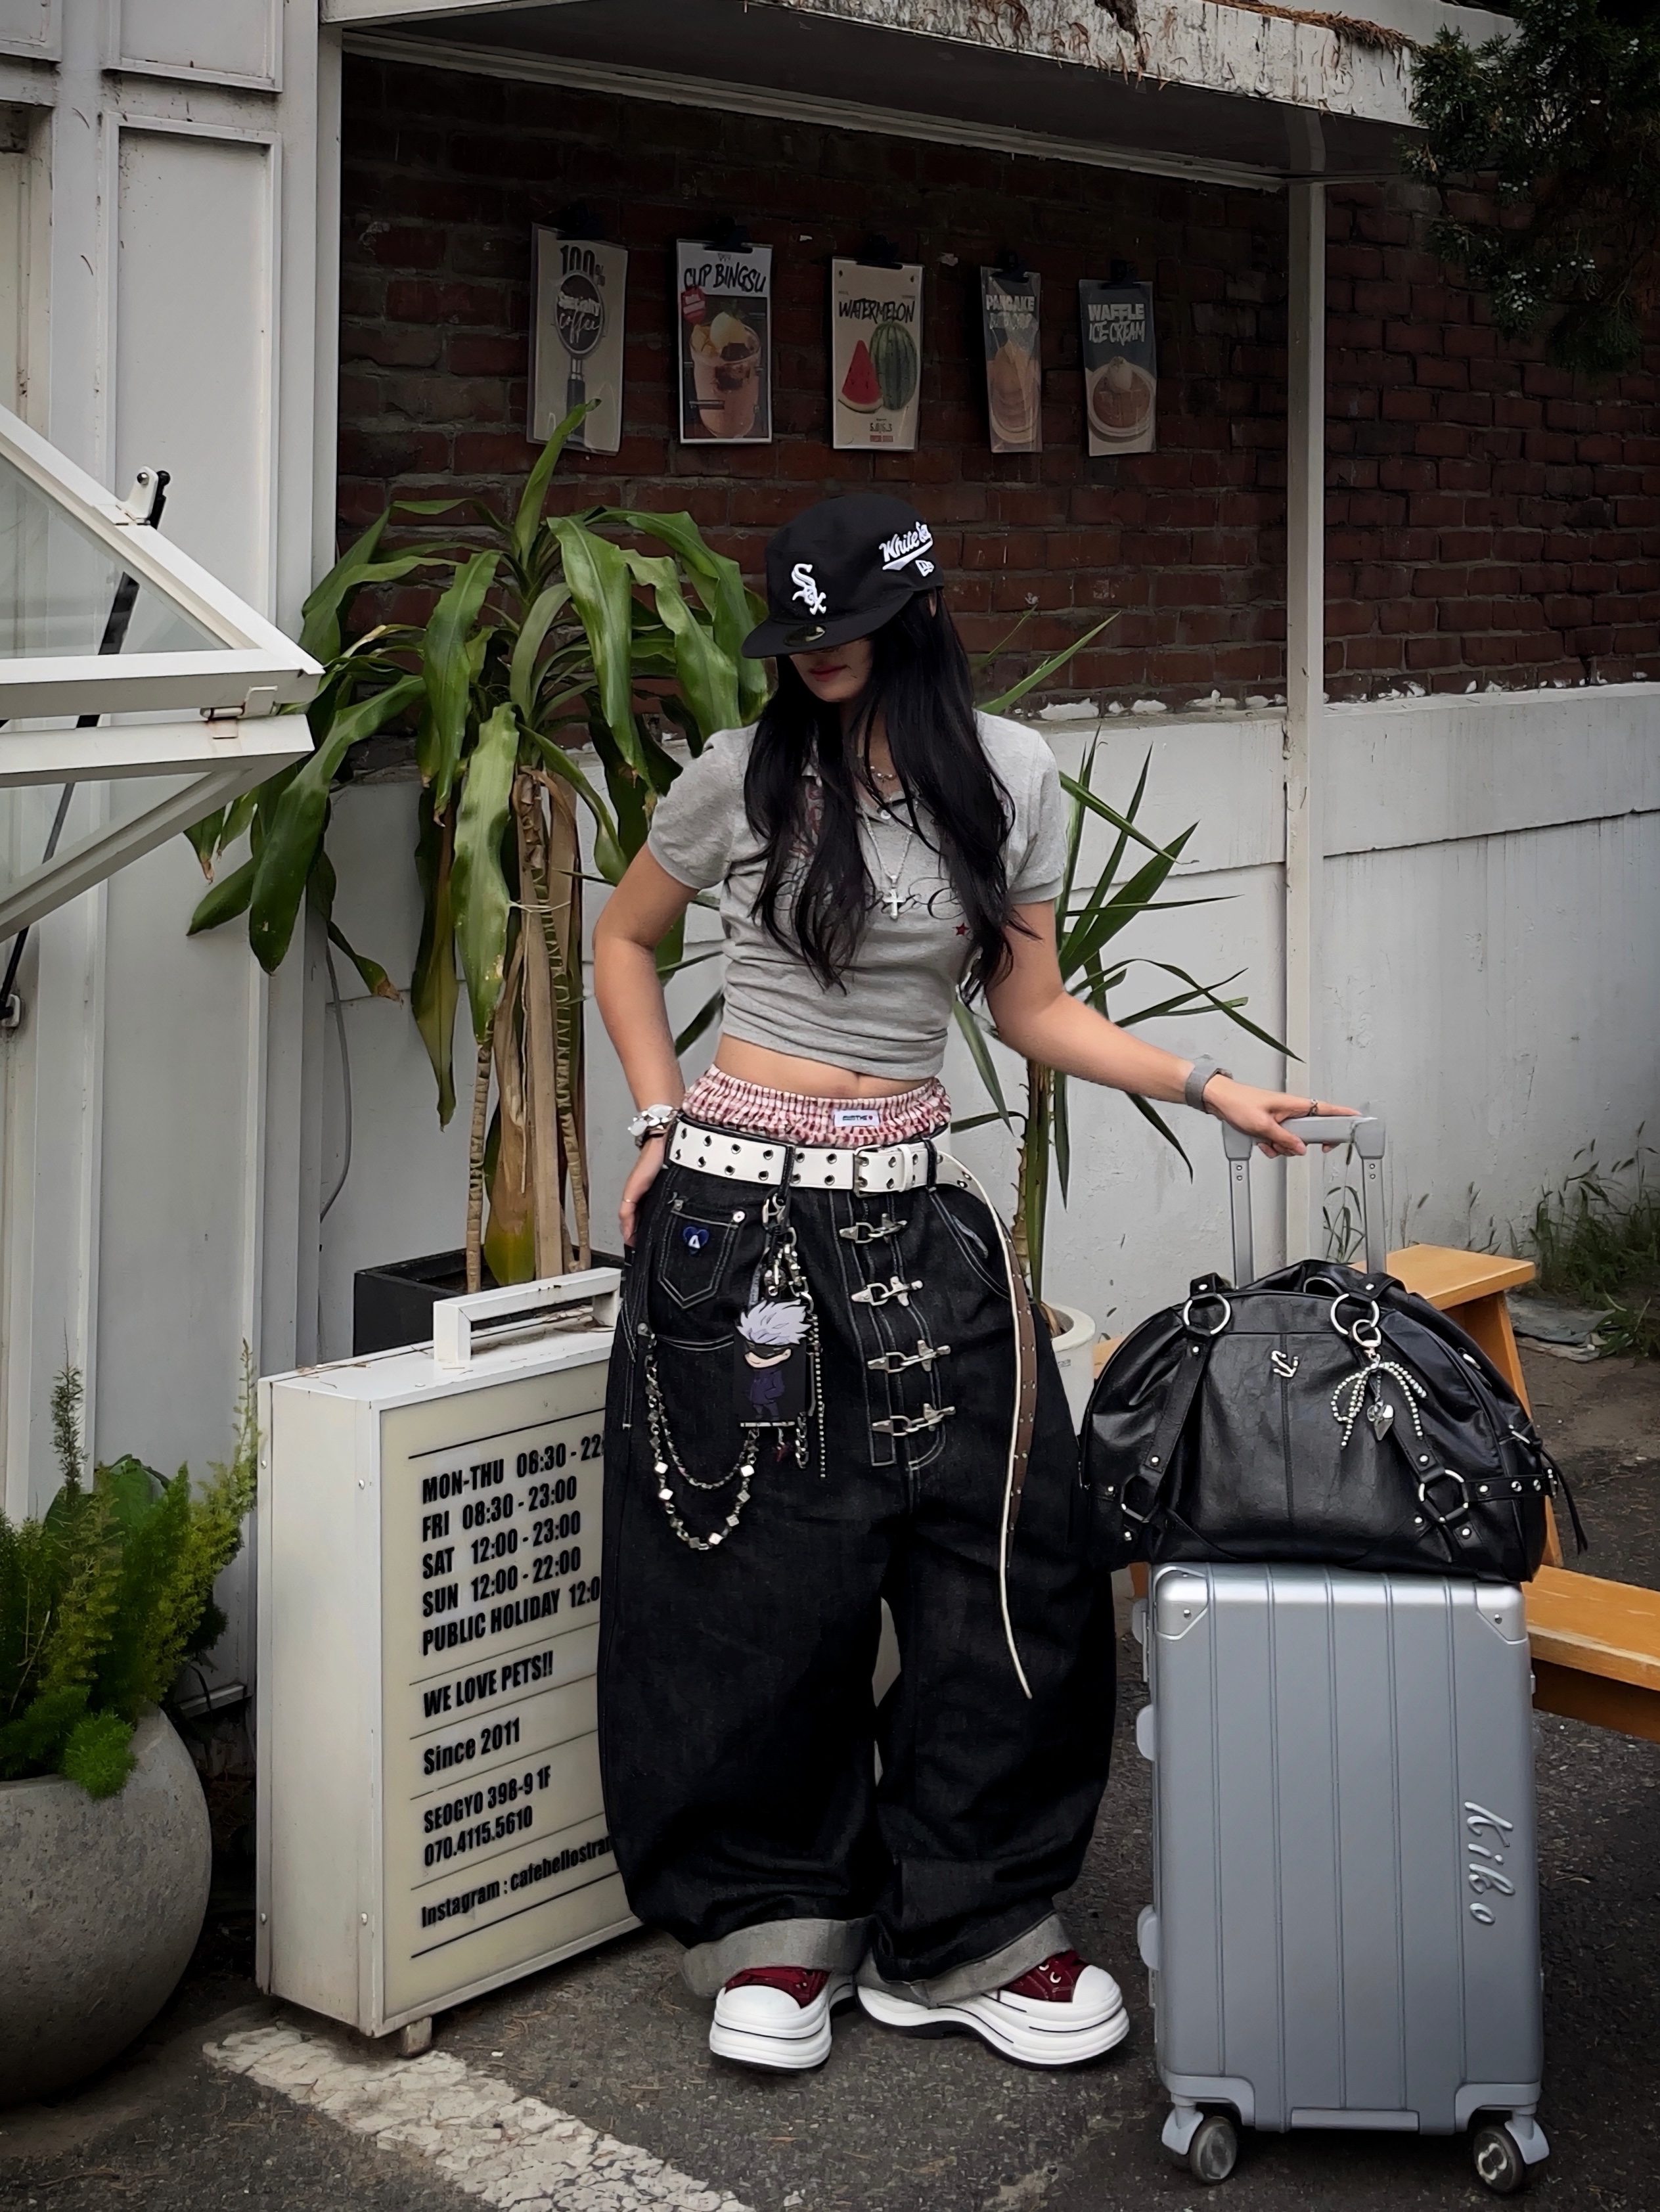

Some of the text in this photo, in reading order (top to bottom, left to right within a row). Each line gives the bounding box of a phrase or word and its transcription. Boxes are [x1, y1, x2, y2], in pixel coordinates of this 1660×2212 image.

[684, 262, 766, 292] CUP BINGSU
[840, 298, 915, 324] WATERMELON
[1088, 304, 1144, 321] WAFFLE
[423, 1458, 504, 1504] MON-THU
[423, 1510, 449, 1543] FRI
[462, 1493, 513, 1530] 08:30
[529, 1476, 577, 1512] 23:00
[423, 1546, 455, 1579] SAT
[471, 1529, 518, 1564] 12:00
[533, 1510, 581, 1547] 23:00
[423, 1583, 459, 1618] SUN
[471, 1566, 518, 1602] 12:00
[533, 1546, 581, 1584] 22:00
[423, 1612, 486, 1656] PUBLIC
[491, 1588, 560, 1634] HOLIDAY
[424, 1650, 553, 1717] WE LOVE PETS!!
[424, 1717, 520, 1775] Since 2011
[424, 1765, 551, 1834] SEOGYO 398-9 1F
[424, 1805, 533, 1866] 070.4115.5610
[422, 1880, 500, 1928] Instagram
